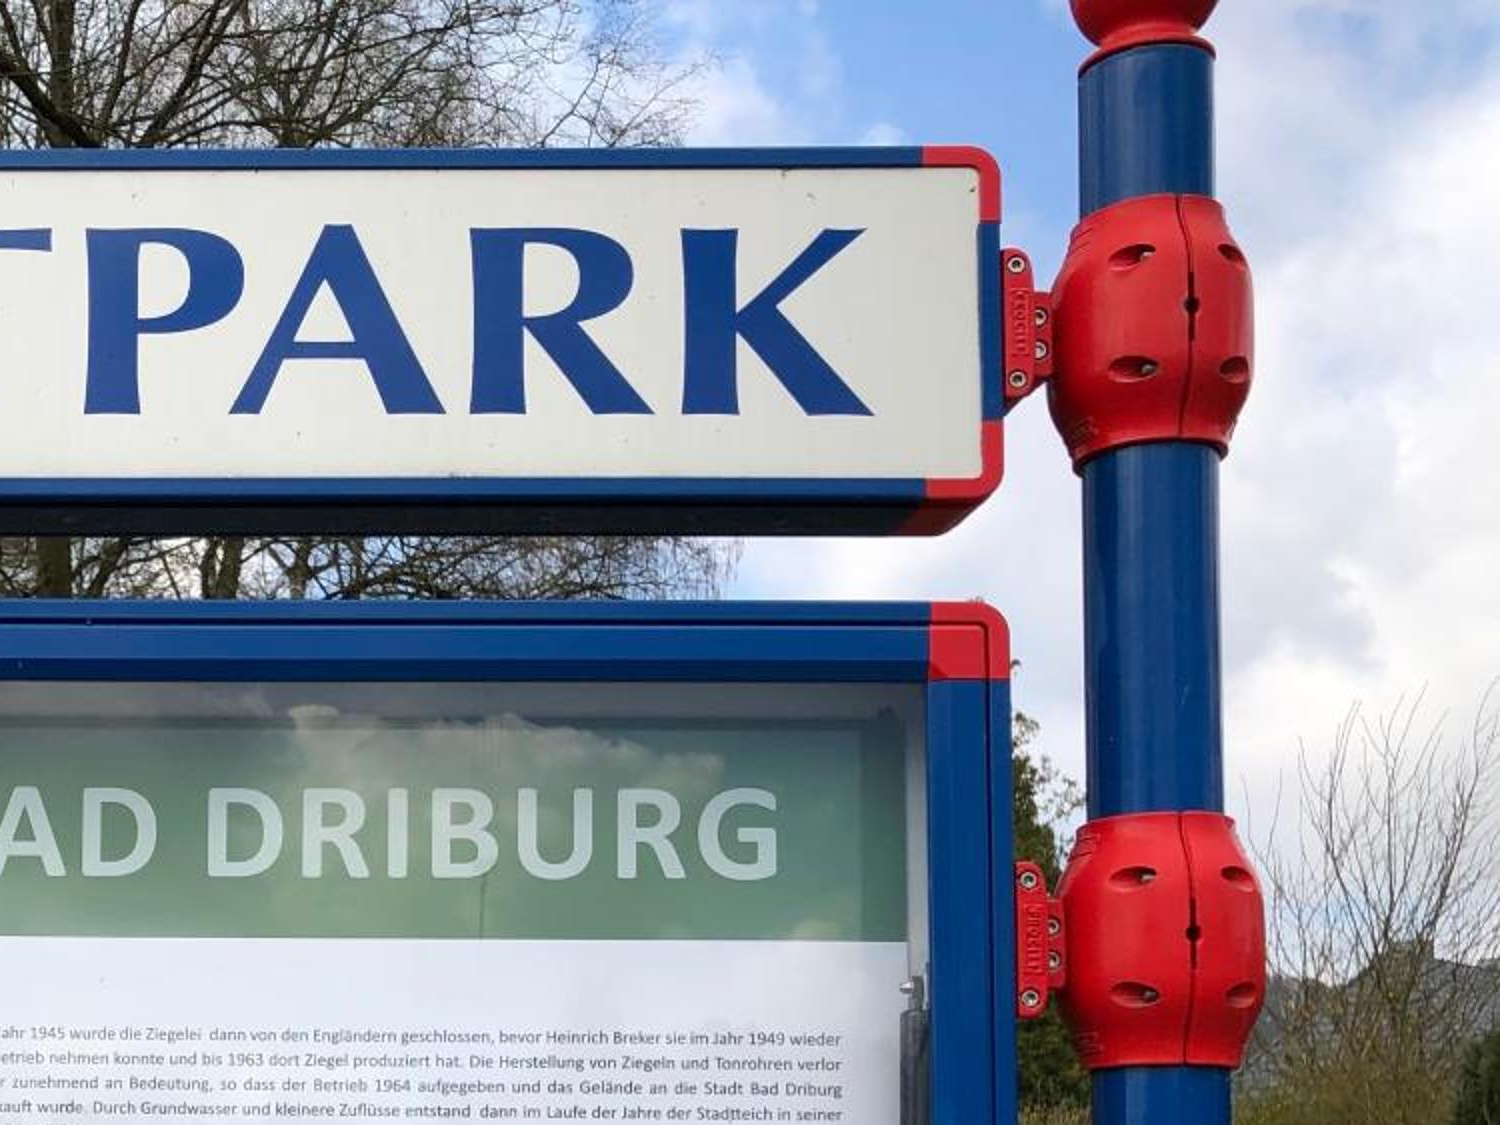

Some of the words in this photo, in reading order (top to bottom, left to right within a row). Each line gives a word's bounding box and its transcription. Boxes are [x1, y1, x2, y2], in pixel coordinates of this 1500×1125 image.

[207, 787, 778, 881] DRIBURG
[36, 1100, 87, 1113] wurde.
[92, 1100, 136, 1113] Durch
[139, 1101, 238, 1114] Grundwasser
[242, 1102, 270, 1115] und
[275, 1102, 334, 1115] kleinere
[339, 1103, 400, 1116] Zuflüsse
[404, 1103, 470, 1117] entstand
[480, 1104, 517, 1117] dann
[522, 1104, 540, 1117] im
[546, 1105, 586, 1118] Laufe
[591, 1105, 619, 1118] der
[620, 1105, 662, 1118] Jahre
[666, 1106, 692, 1119] der
[696, 1106, 772, 1119] Stadtteich
[777, 1107, 790, 1120] in
[796, 1107, 843, 1120] seiner
